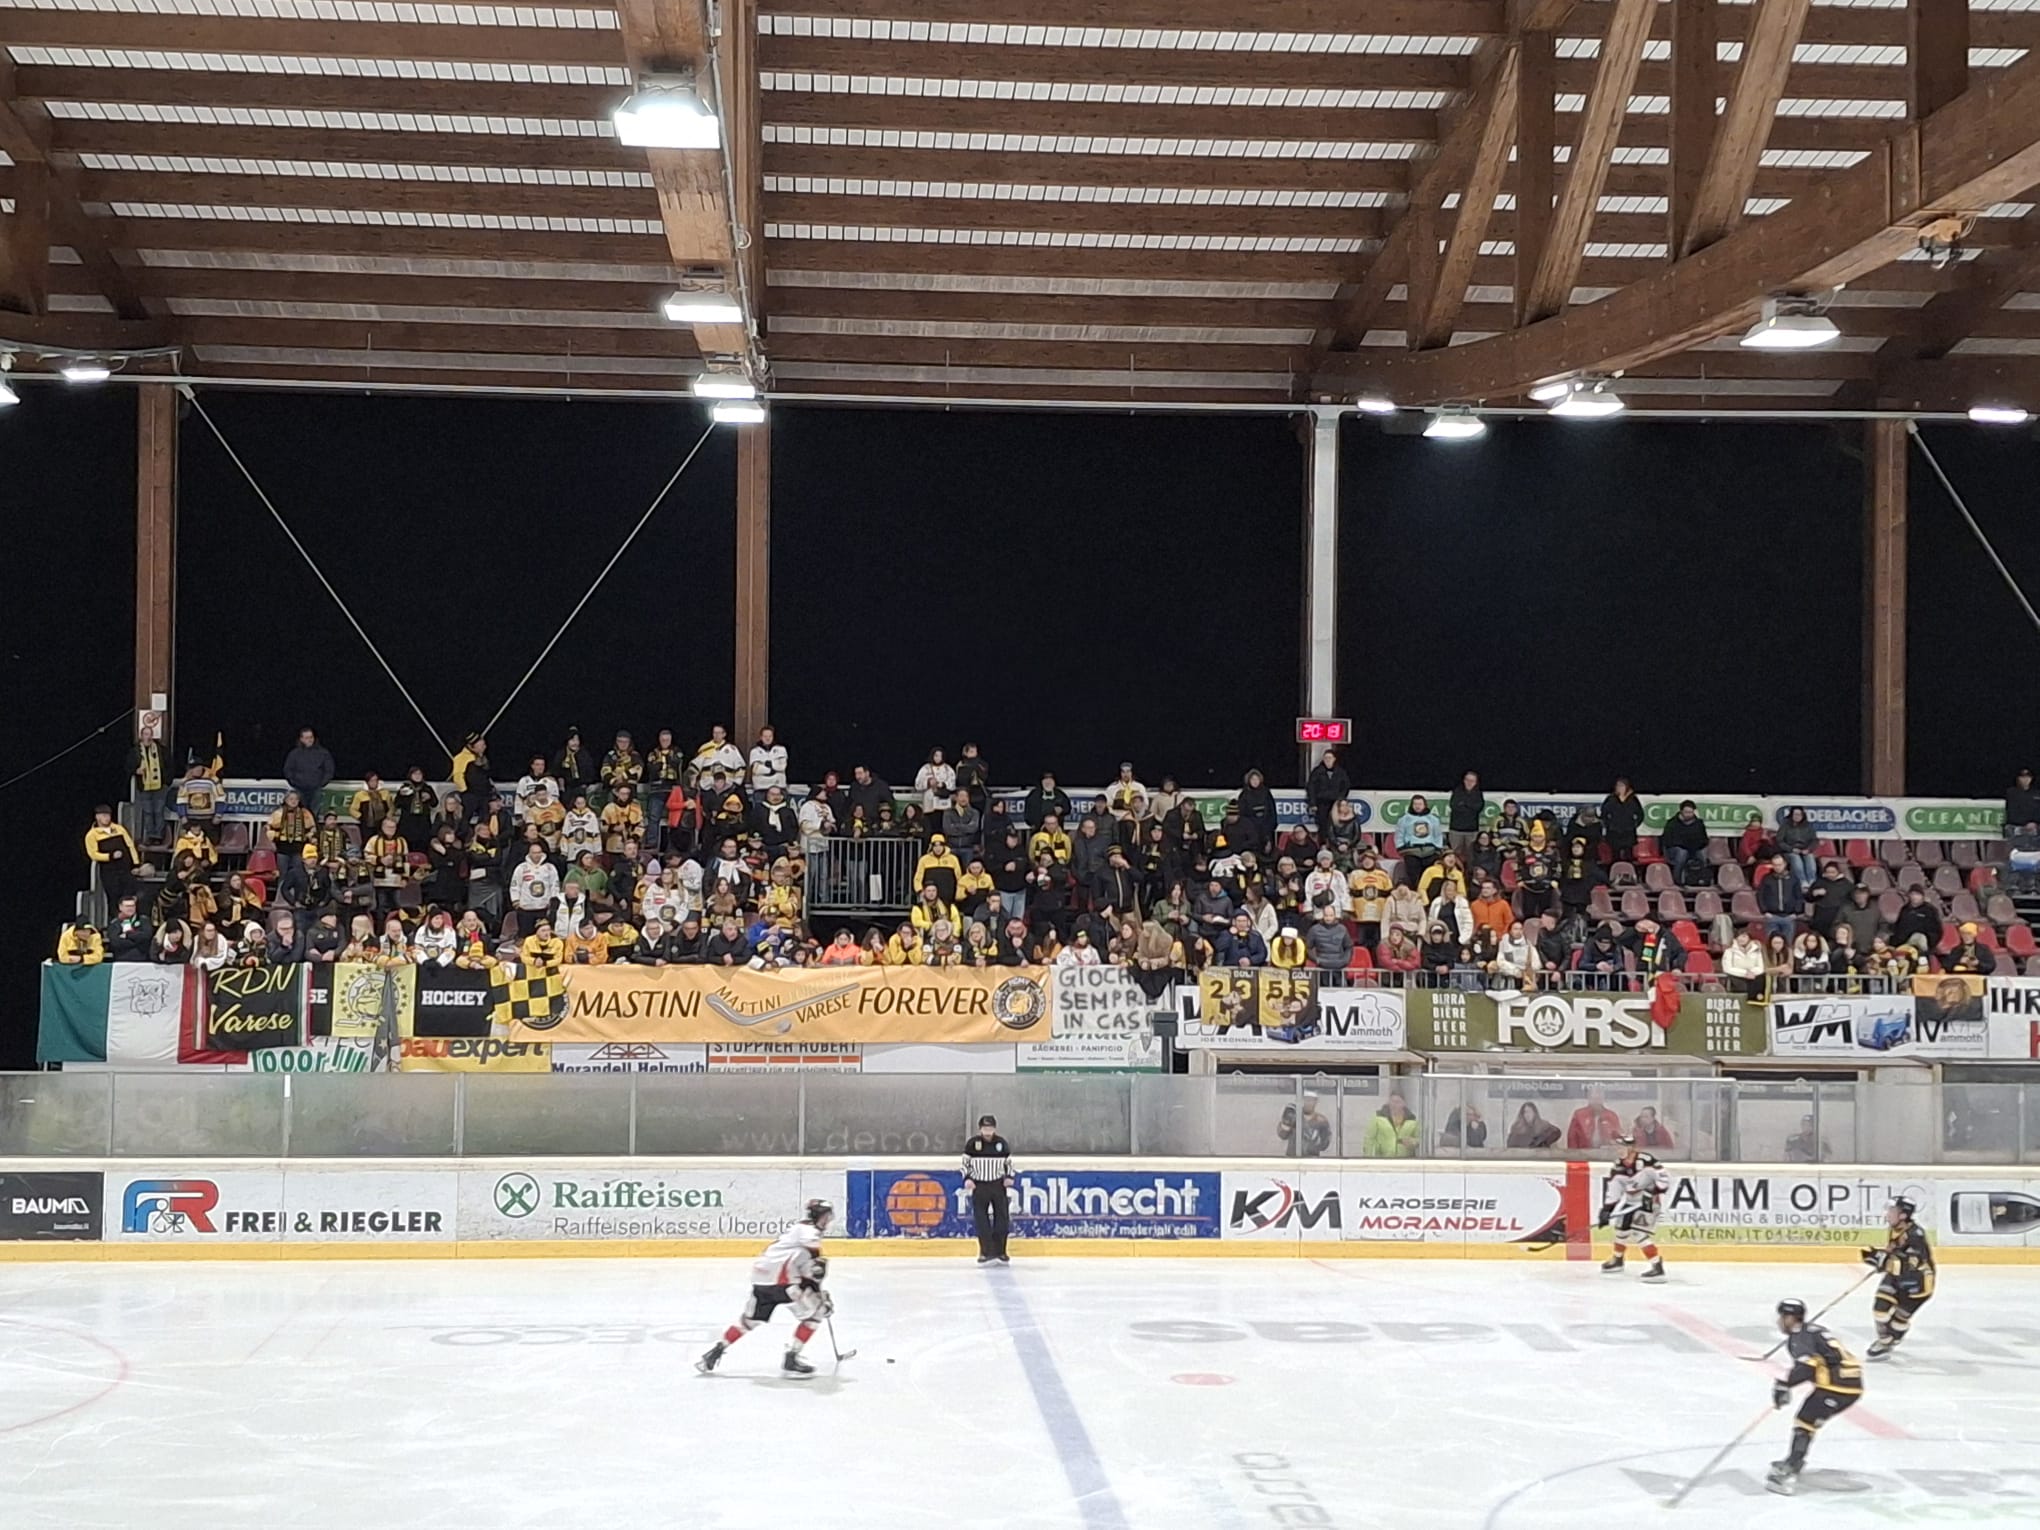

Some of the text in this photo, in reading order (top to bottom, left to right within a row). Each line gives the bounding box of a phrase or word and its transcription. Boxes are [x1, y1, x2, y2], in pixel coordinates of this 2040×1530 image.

[209, 963, 296, 998] RDN
[421, 990, 487, 1006] HOCKEY
[572, 990, 701, 1018] MASTINI
[714, 985, 782, 1015] MASTINI
[857, 986, 989, 1016] FOREVER
[1432, 993, 1466, 1005] BIRRA
[796, 993, 851, 1024] VARESE
[209, 1003, 294, 1035] Varese
[1064, 1013, 1083, 1029] IN
[1326, 1006, 1392, 1036] Mammoth
[1434, 1020, 1466, 1032] BEER
[1434, 1034, 1467, 1046] BIER
[1706, 1026, 1740, 1038] BEER
[1707, 1039, 1740, 1051] BIER
[638, 1061, 704, 1072] Helmuth
[553, 1181, 723, 1208] Raiffeisen
[1358, 1197, 1497, 1210] KAROSSERIE
[1230, 1189, 1342, 1229] KM
[226, 1211, 442, 1232] FREI & RIEGLER
[553, 1216, 710, 1236] Raiffeisenkasse
[1359, 1217, 1524, 1231] MORANDELL
